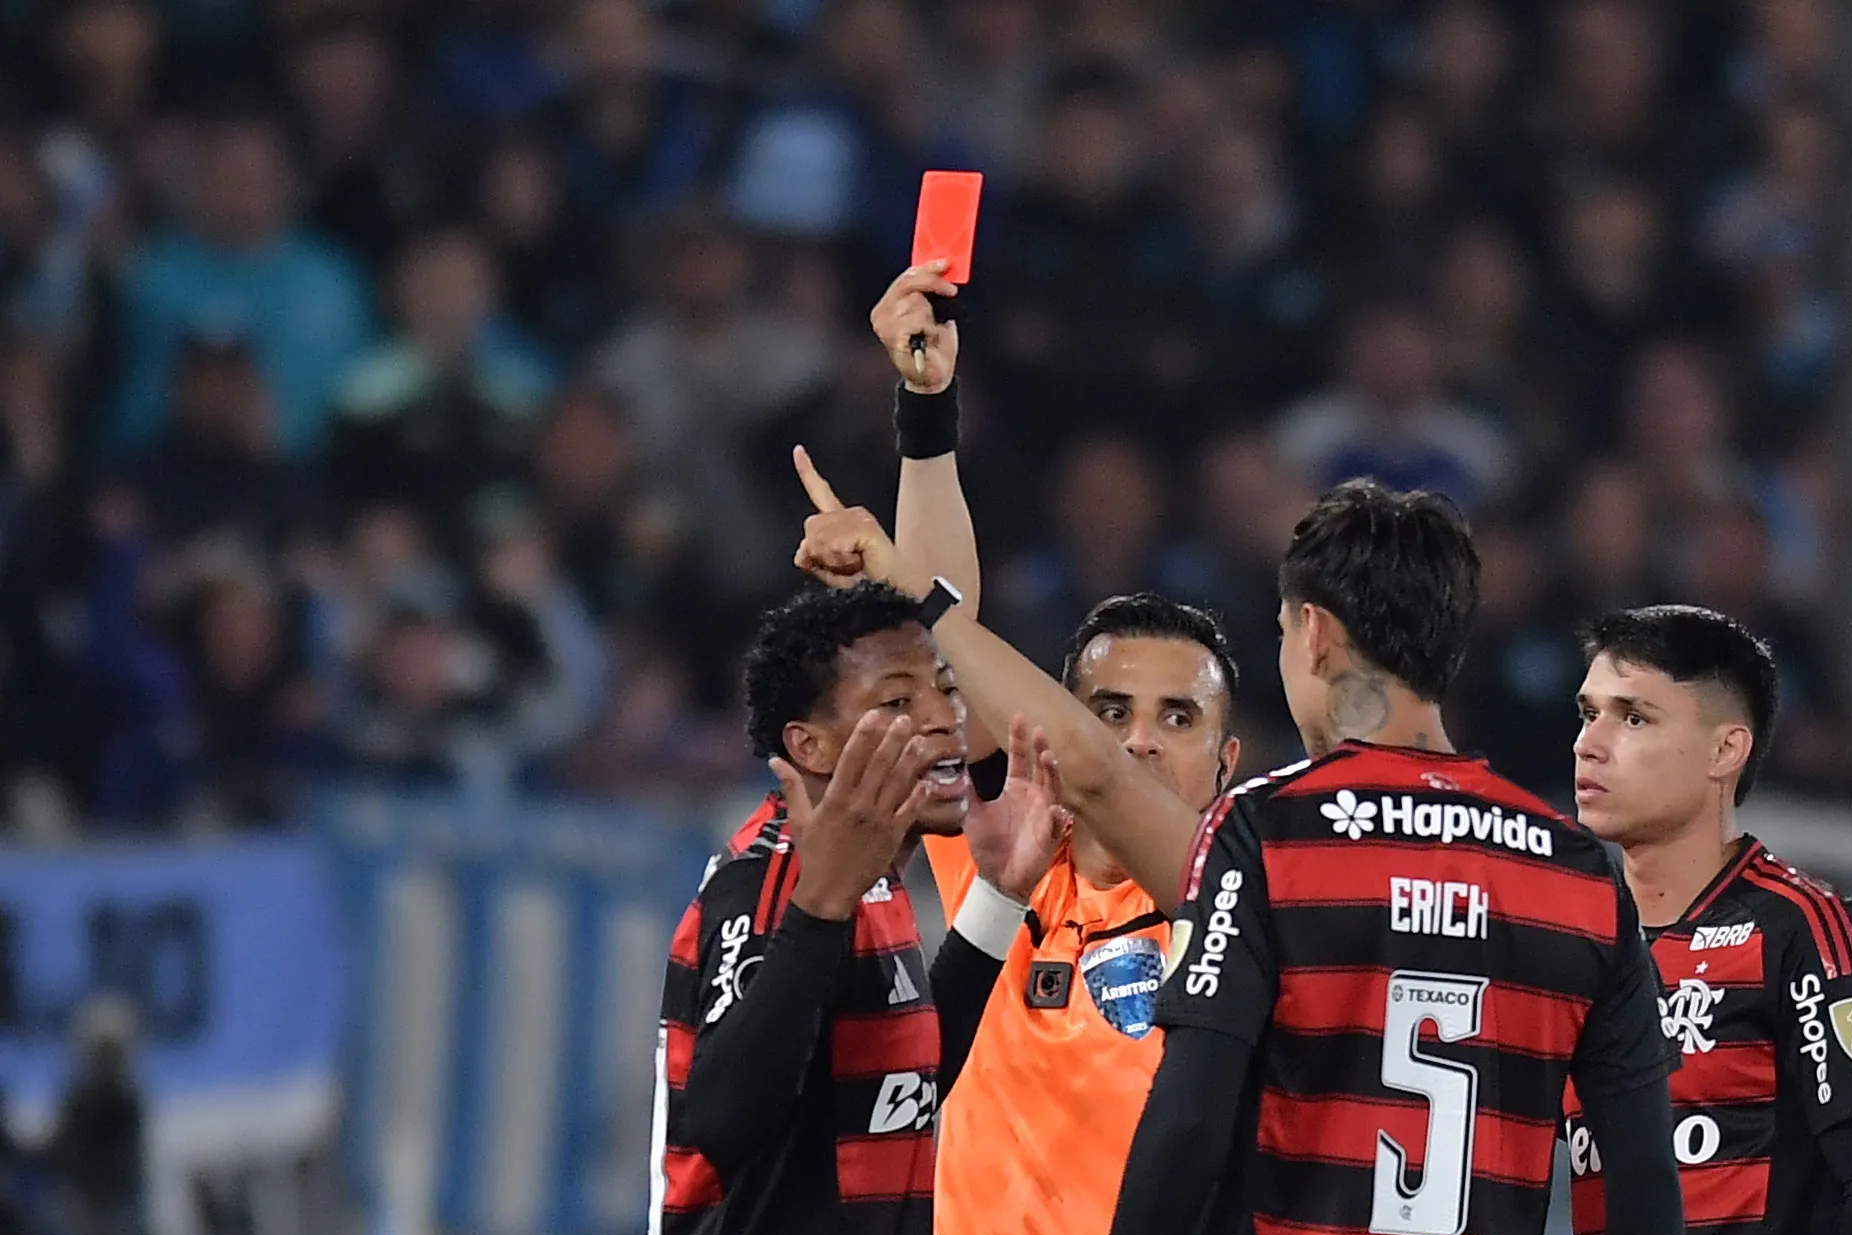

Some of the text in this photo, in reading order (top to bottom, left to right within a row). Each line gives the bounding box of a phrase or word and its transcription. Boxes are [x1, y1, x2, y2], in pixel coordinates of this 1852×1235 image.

[1380, 795, 1553, 857] Hapvida
[1186, 869, 1243, 998] Shopee
[1390, 876, 1489, 940] ERICH
[1710, 921, 1755, 949] BRB
[1101, 979, 1159, 1002] ÁRBITRO
[1408, 988, 1470, 1007] TEXACO
[1790, 973, 1832, 1105] Shopee
